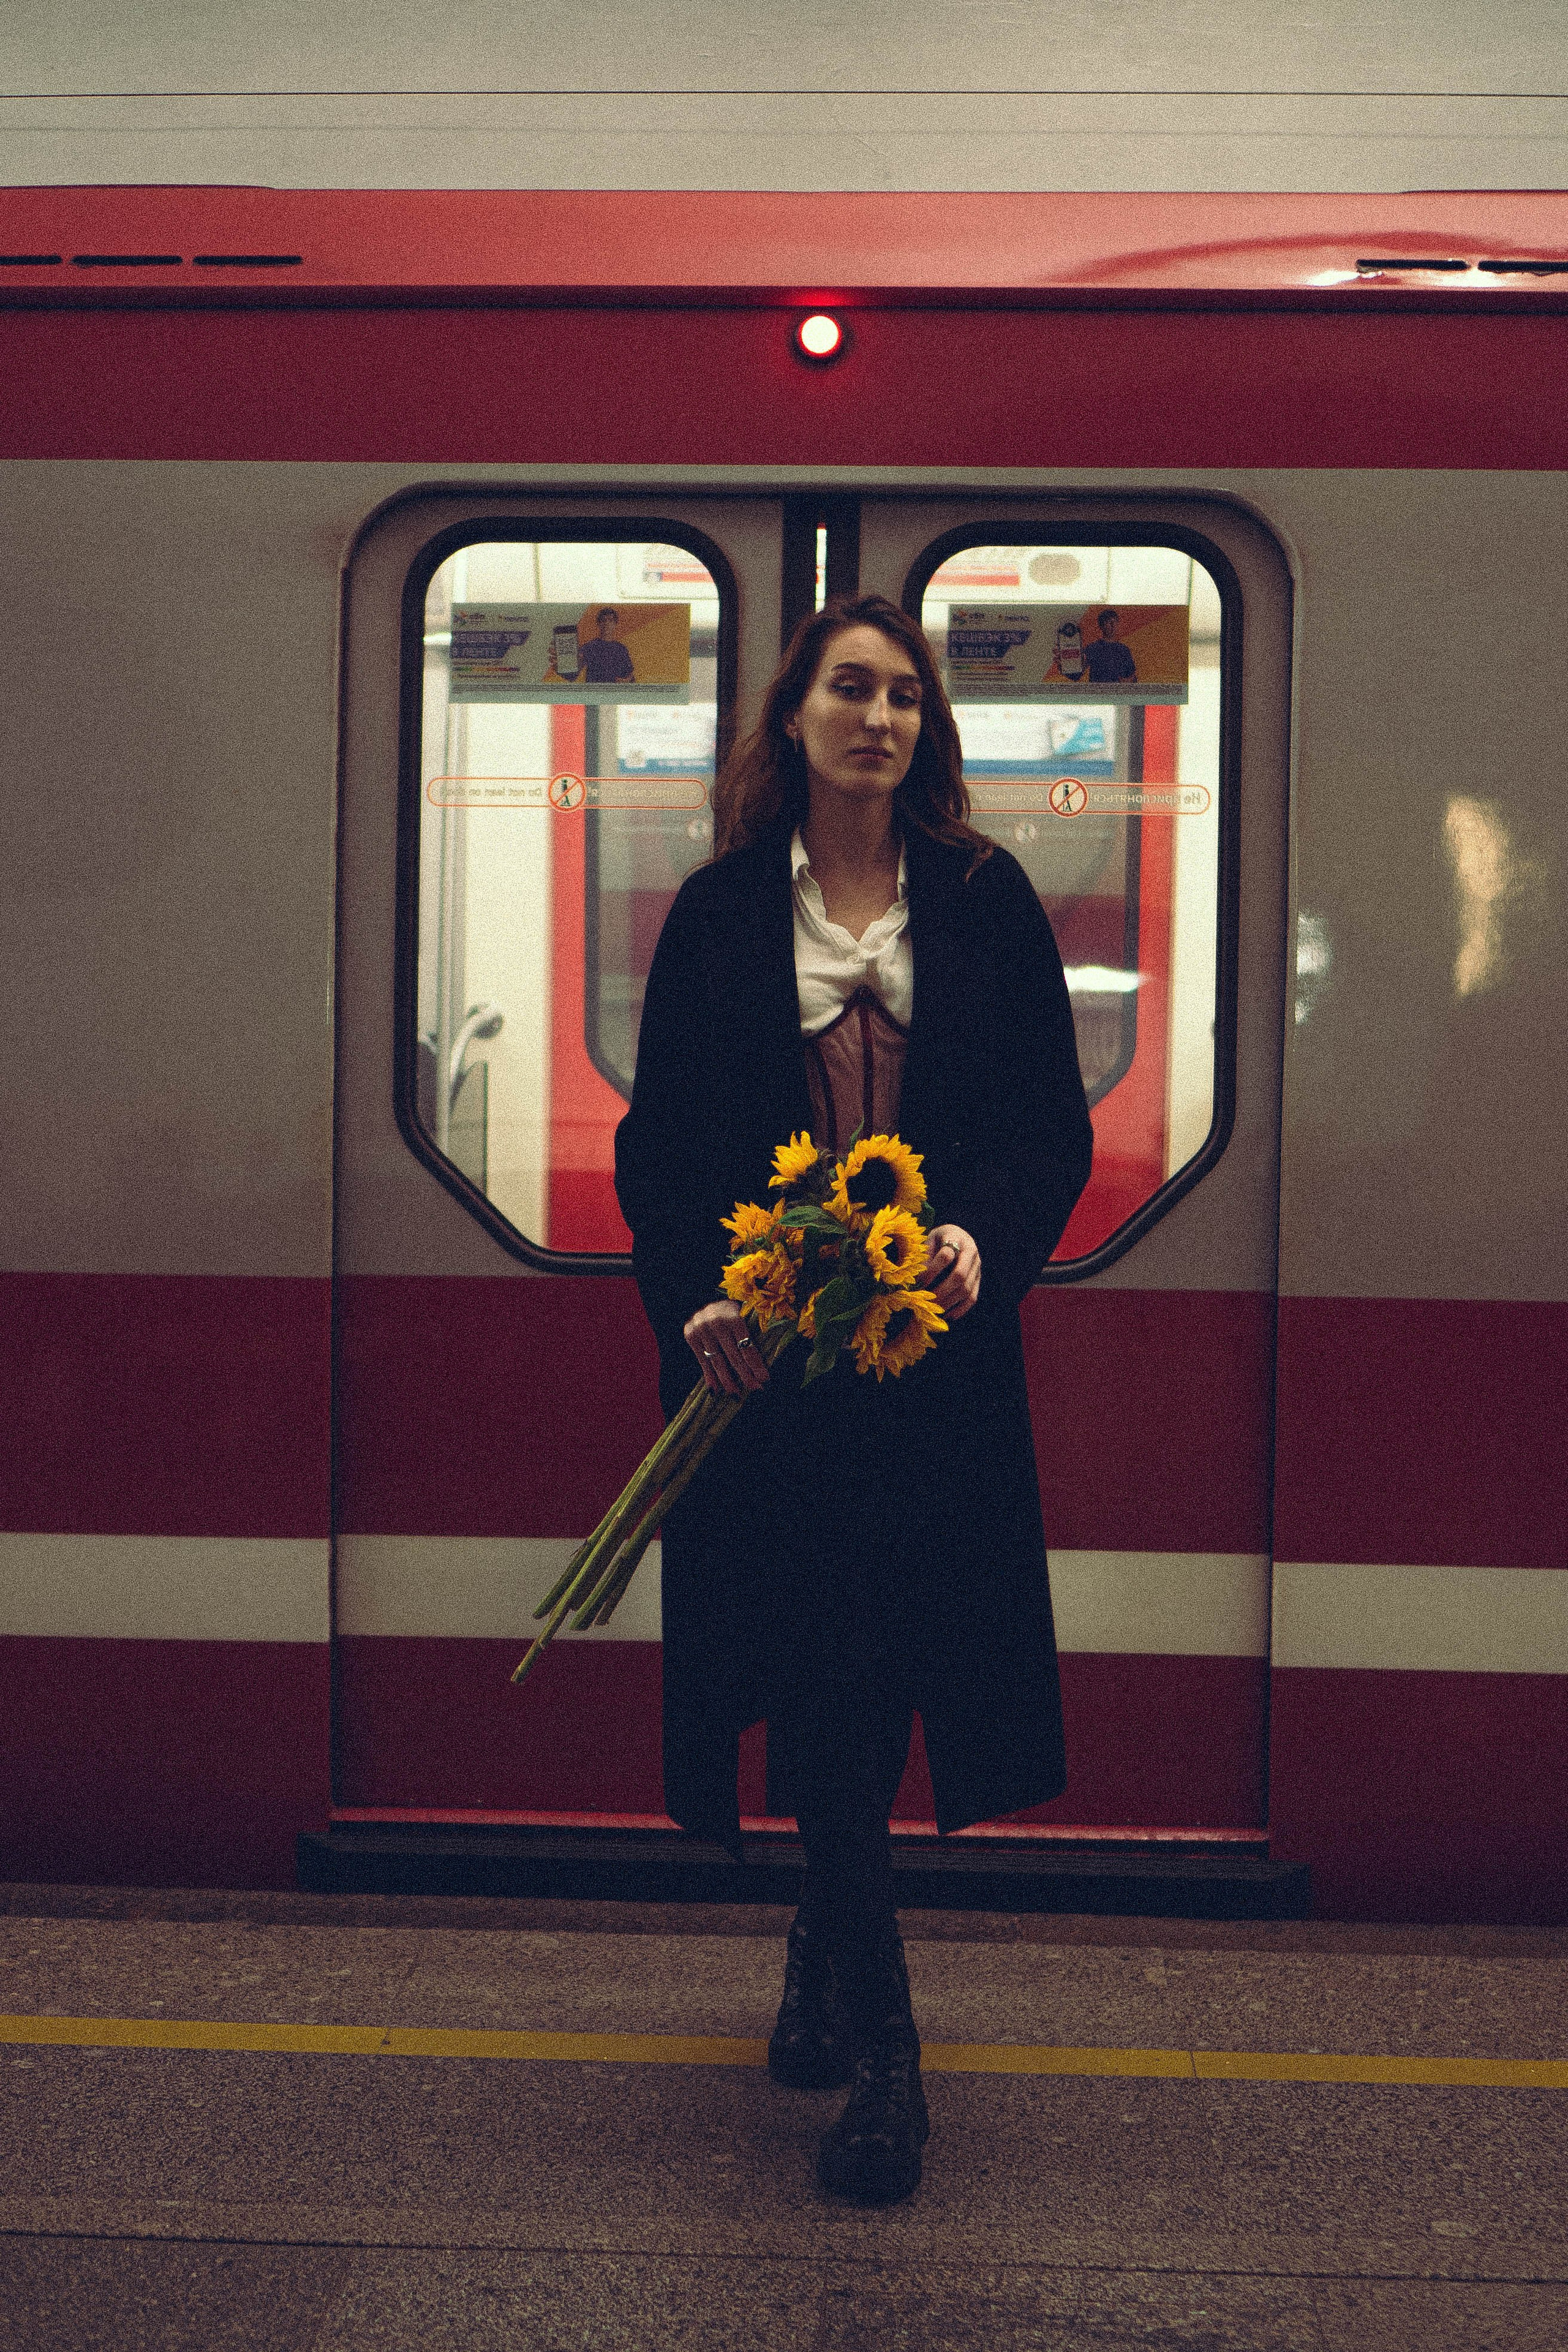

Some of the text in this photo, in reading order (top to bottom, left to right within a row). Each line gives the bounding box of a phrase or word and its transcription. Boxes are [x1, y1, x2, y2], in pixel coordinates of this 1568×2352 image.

[504, 633, 521, 643] 3%
[951, 632, 1022, 643] КЕШБЭК 3%
[961, 646, 997, 656] ЛЕНТЕ
